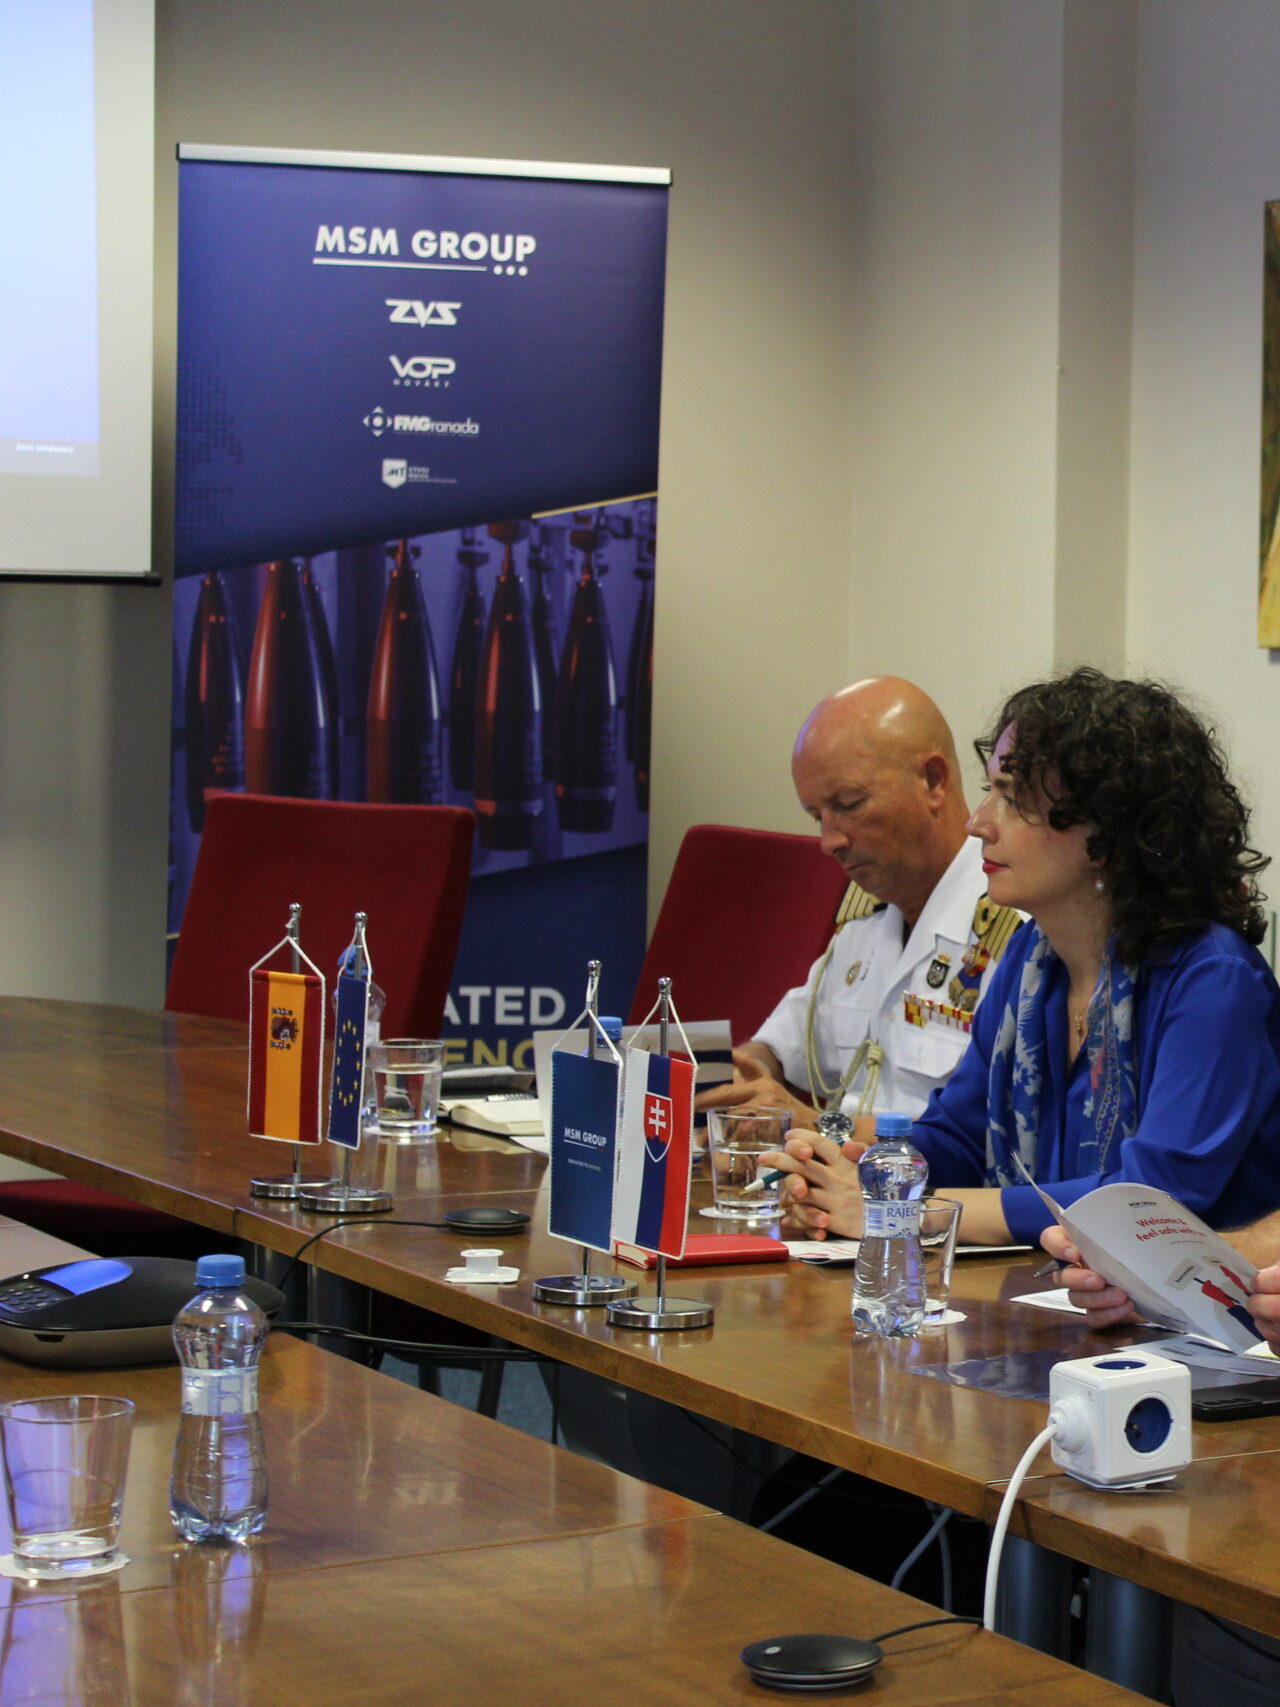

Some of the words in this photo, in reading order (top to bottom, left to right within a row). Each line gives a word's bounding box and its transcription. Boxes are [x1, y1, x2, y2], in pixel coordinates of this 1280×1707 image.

[315, 225, 399, 255] MSM
[411, 230, 536, 262] GROUP
[385, 299, 462, 328] ZVS
[389, 355, 456, 379] VOP
[564, 1127, 581, 1141] MSM
[582, 1131, 607, 1147] GROUP
[887, 1206, 918, 1219] RAJEC
[1136, 1228, 1160, 1242] feel
